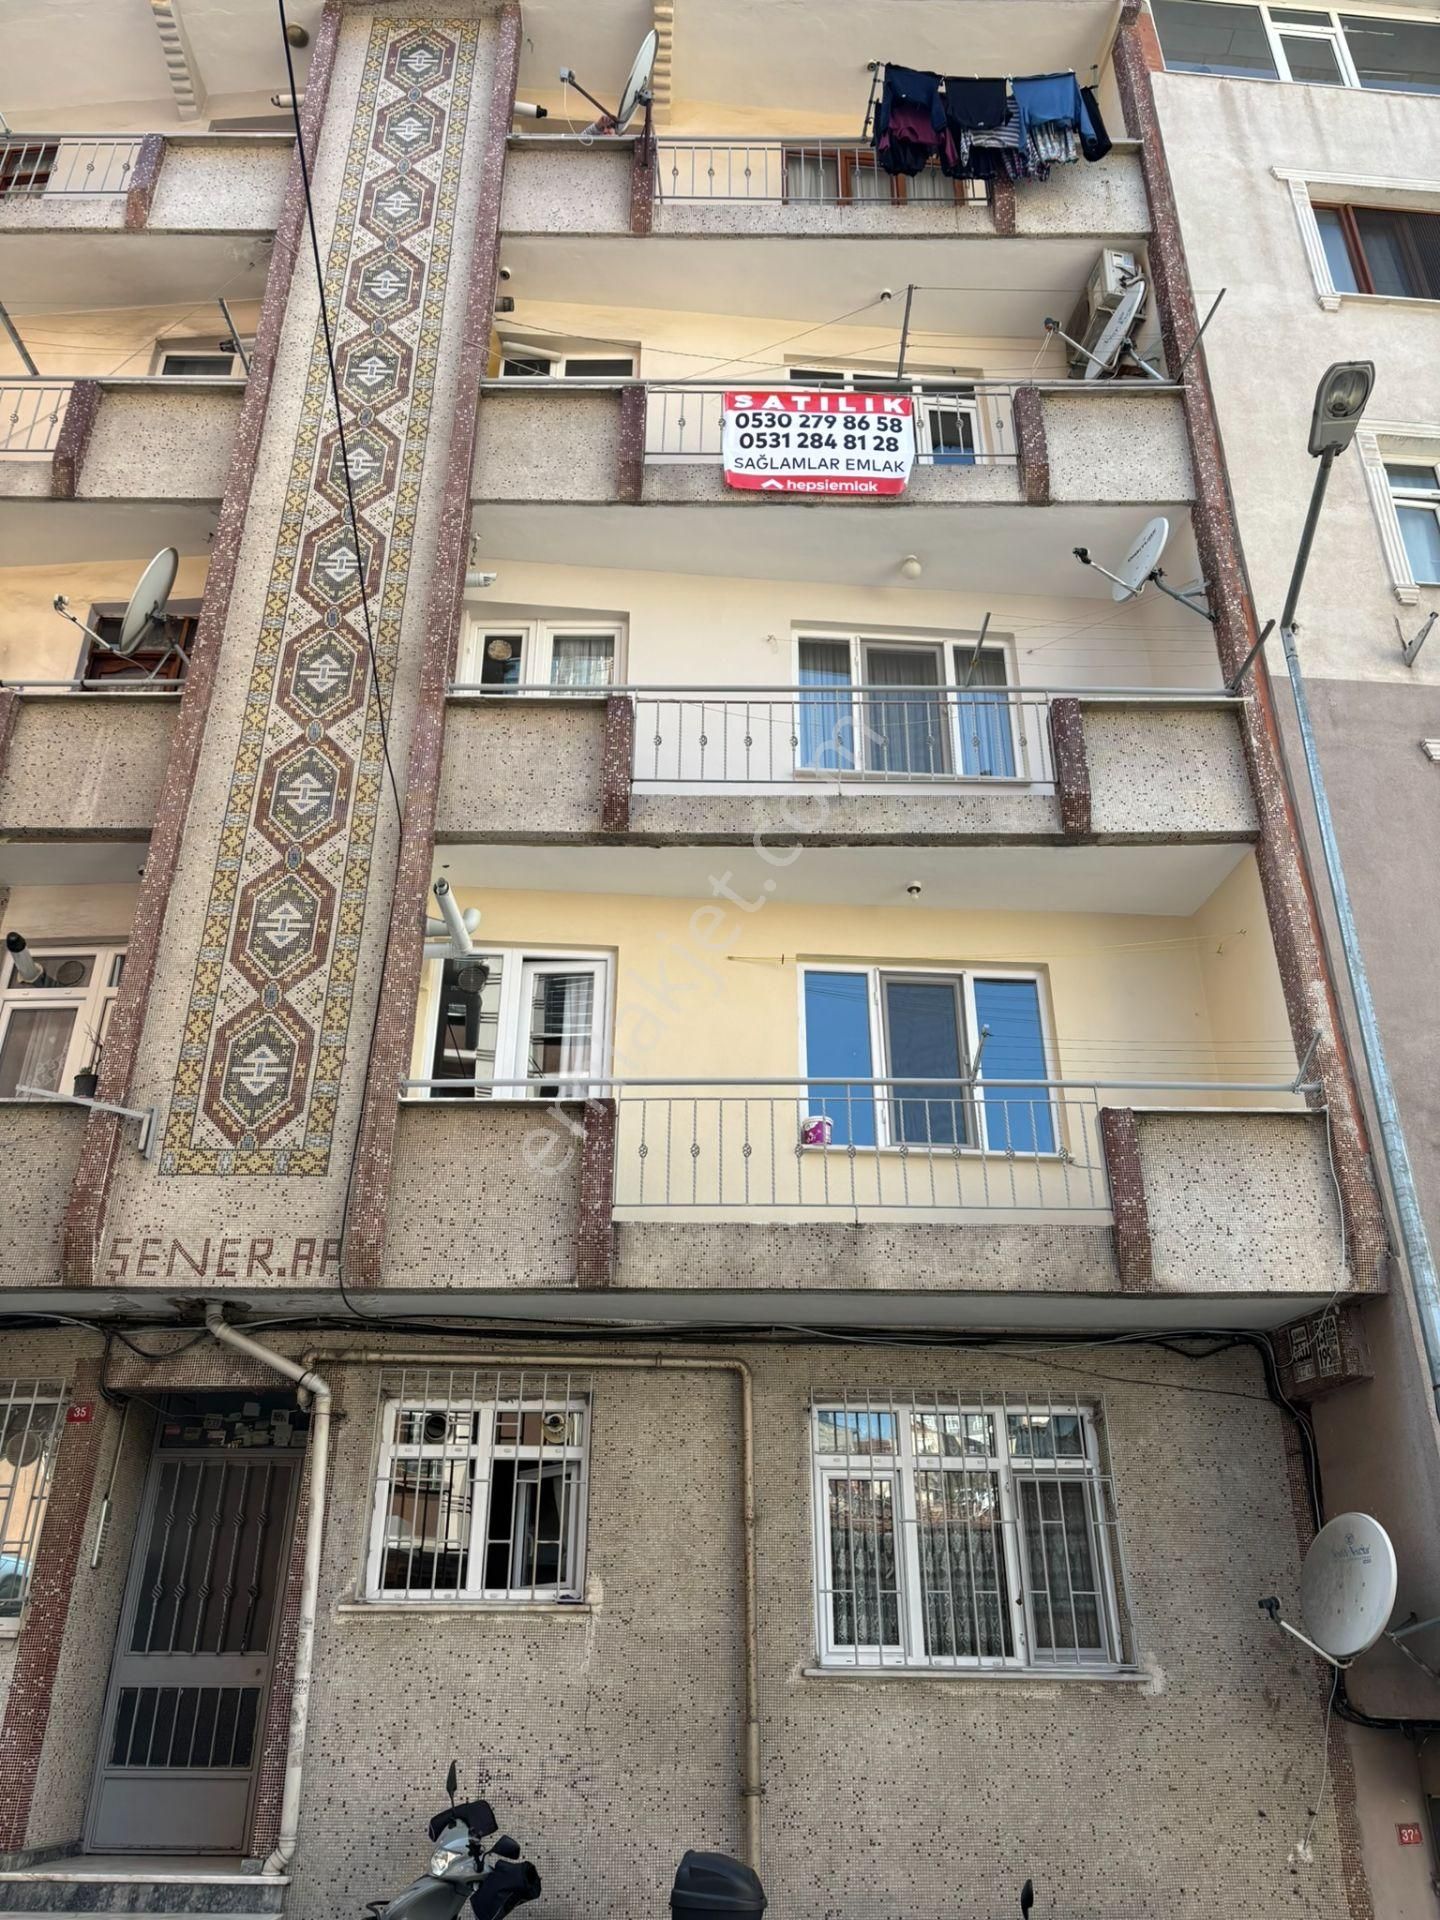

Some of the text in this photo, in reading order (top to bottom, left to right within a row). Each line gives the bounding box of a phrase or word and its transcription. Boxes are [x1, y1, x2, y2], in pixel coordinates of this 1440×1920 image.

[734, 395, 905, 413] SATILIK
[735, 412, 903, 433] 0530 279 86 58
[739, 432, 899, 452] 0531 284 81 28
[734, 454, 905, 473] SAĞLAMLAR EMLAK
[787, 479, 878, 492] hepsiemlak
[74, 1407, 87, 1418] 35
